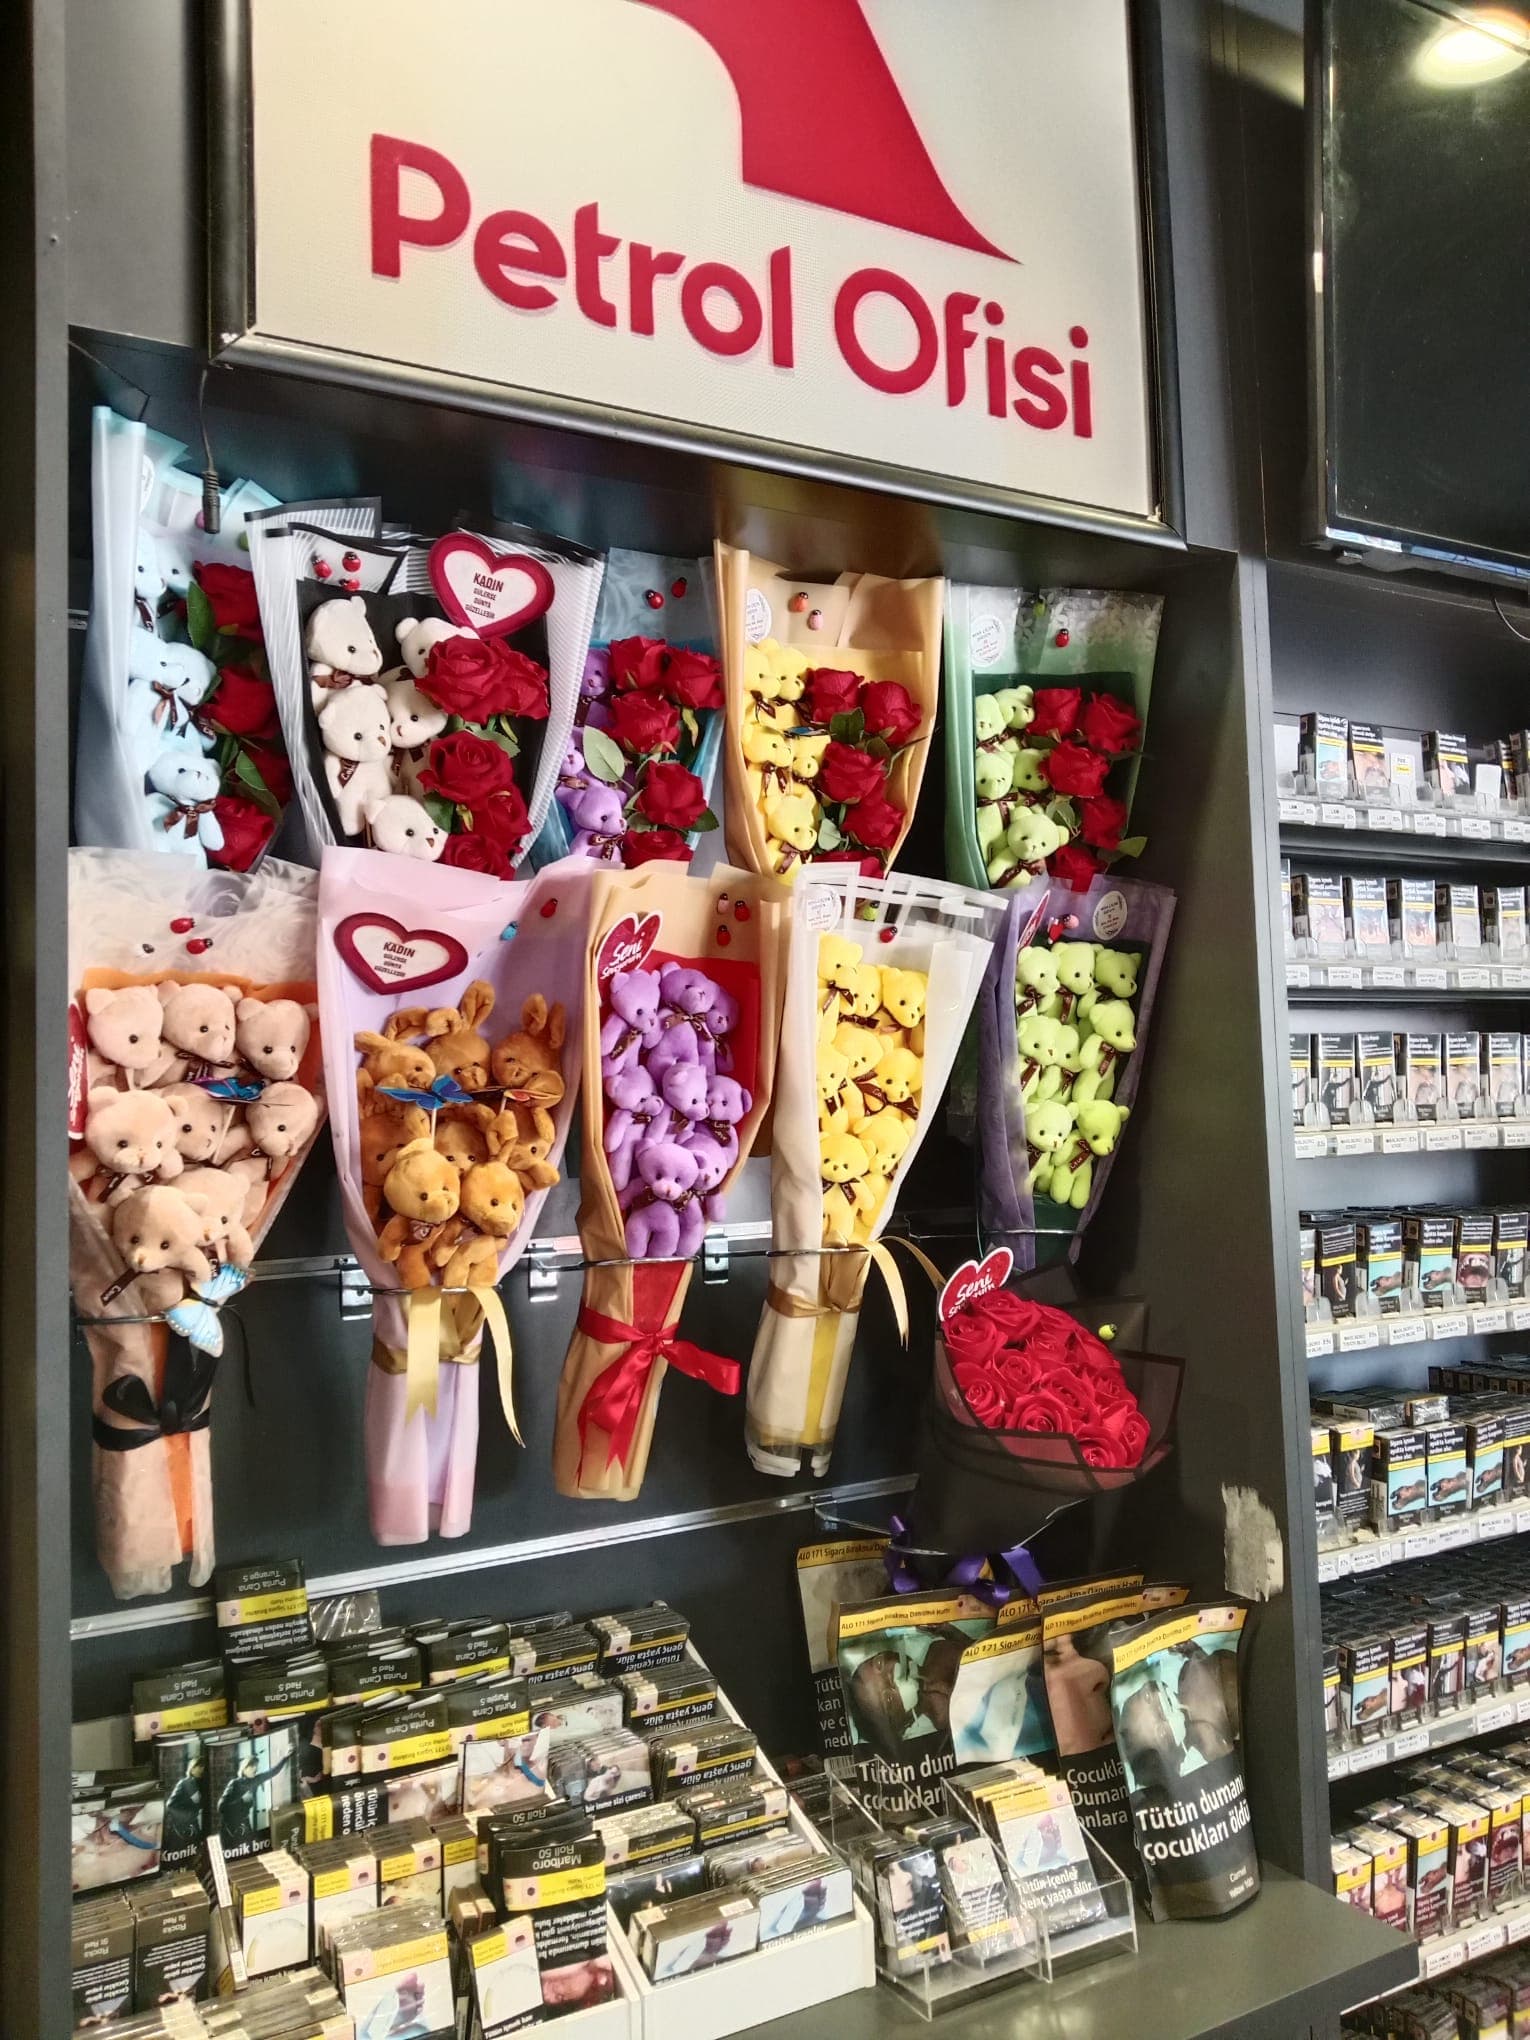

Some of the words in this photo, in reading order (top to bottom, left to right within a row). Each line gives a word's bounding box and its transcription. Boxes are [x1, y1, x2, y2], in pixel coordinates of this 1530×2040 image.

[370, 133, 795, 368] Petrol
[834, 266, 1093, 439] Ofisi
[473, 573, 504, 592] KADIN
[383, 942, 416, 958] KADIN
[609, 932, 645, 966] Seni
[955, 1268, 992, 1306] Seni
[799, 1551, 811, 1561] ALO
[812, 1549, 824, 1559] 171
[824, 1546, 846, 1559] Sigara
[238, 1582, 261, 1593] Cana
[262, 1578, 287, 1589] Punta
[1000, 1606, 1016, 1619] ALO
[1018, 1604, 1031, 1615] 171
[472, 1640, 488, 1649] Red
[666, 1643, 684, 1654] genç
[964, 1646, 980, 1658] ALO
[981, 1643, 997, 1652] 171
[455, 1652, 477, 1661] Cana
[478, 1647, 499, 1657] Punta
[639, 1646, 667, 1661] yaşta
[615, 1652, 638, 1666] ölür.
[656, 1654, 681, 1667] Tütün
[377, 1664, 395, 1672] Red
[544, 1665, 571, 1678] yaşta
[571, 1661, 594, 1673] genç
[624, 1659, 655, 1673] içenler
[179, 1679, 198, 1689] Red
[359, 1676, 382, 1686] Cana
[382, 1672, 408, 1683] Punta
[284, 1681, 302, 1690] Red
[160, 1692, 185, 1703] Cana
[185, 1687, 212, 1698] Punta
[264, 1692, 289, 1703] Cana
[290, 1688, 315, 1700] Punta
[486, 1692, 510, 1705] Purple
[495, 1701, 517, 1712] Punta
[691, 1701, 714, 1715] genç
[817, 1698, 841, 1713] kan
[472, 1707, 494, 1718] Cana
[664, 1707, 691, 1723] yaşta
[409, 1719, 435, 1730] Punta
[643, 1715, 664, 1728] ölür.
[820, 1718, 836, 1731] ve
[385, 1724, 409, 1735] Cana
[729, 1758, 752, 1772] genç
[702, 1764, 729, 1780] yaşta
[858, 1762, 916, 1785] Tütün
[680, 1773, 702, 1786] ölür.
[367, 1787, 379, 1817] Tütün
[1071, 1785, 1129, 1807] Duman
[1136, 1801, 1199, 1831] Tütün
[1199, 1774, 1246, 1815] dumanı
[340, 1795, 354, 1828] neden
[512, 1812, 526, 1823] 50
[527, 1809, 546, 1820] Roll
[1076, 1810, 1129, 1828] onlara
[221, 1841, 251, 1859] ronik
[1143, 1820, 1230, 1867] çocukları
[538, 1848, 552, 1859] 50
[554, 1844, 575, 1857] Roll
[532, 1854, 582, 1871] Marlboro
